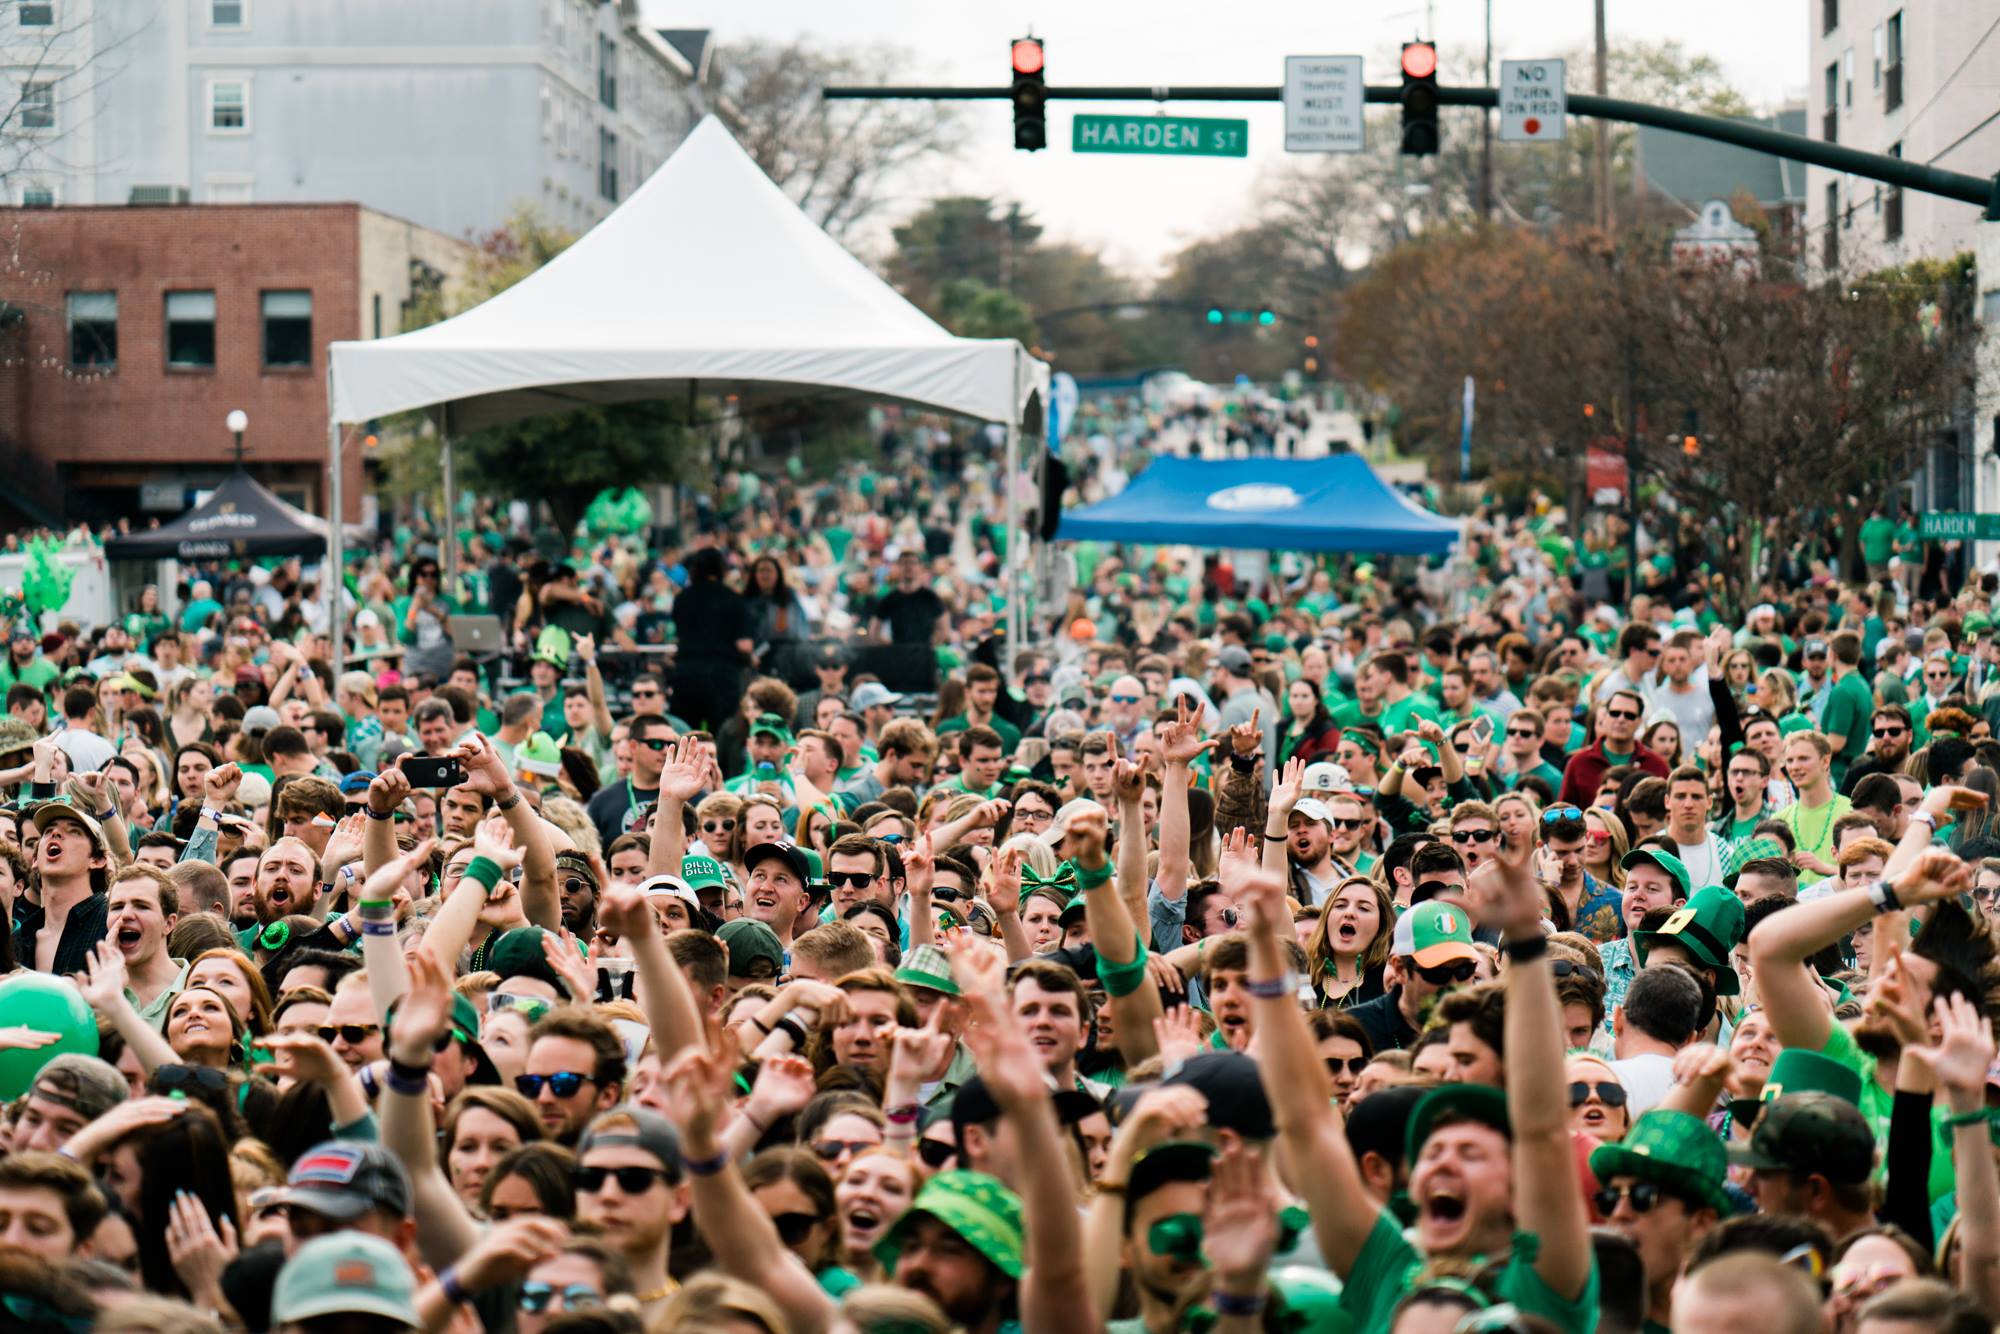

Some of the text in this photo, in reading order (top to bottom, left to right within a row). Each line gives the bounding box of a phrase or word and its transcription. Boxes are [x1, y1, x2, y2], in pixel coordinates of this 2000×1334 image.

[1516, 66, 1547, 81] NO
[1513, 86, 1552, 99] TURN
[1505, 101, 1560, 115] ON RED
[1081, 122, 1238, 149] HARDEN ST
[1924, 517, 1976, 534] HARDEN
[685, 861, 713, 870] DILLY
[686, 868, 714, 877] DILLY
